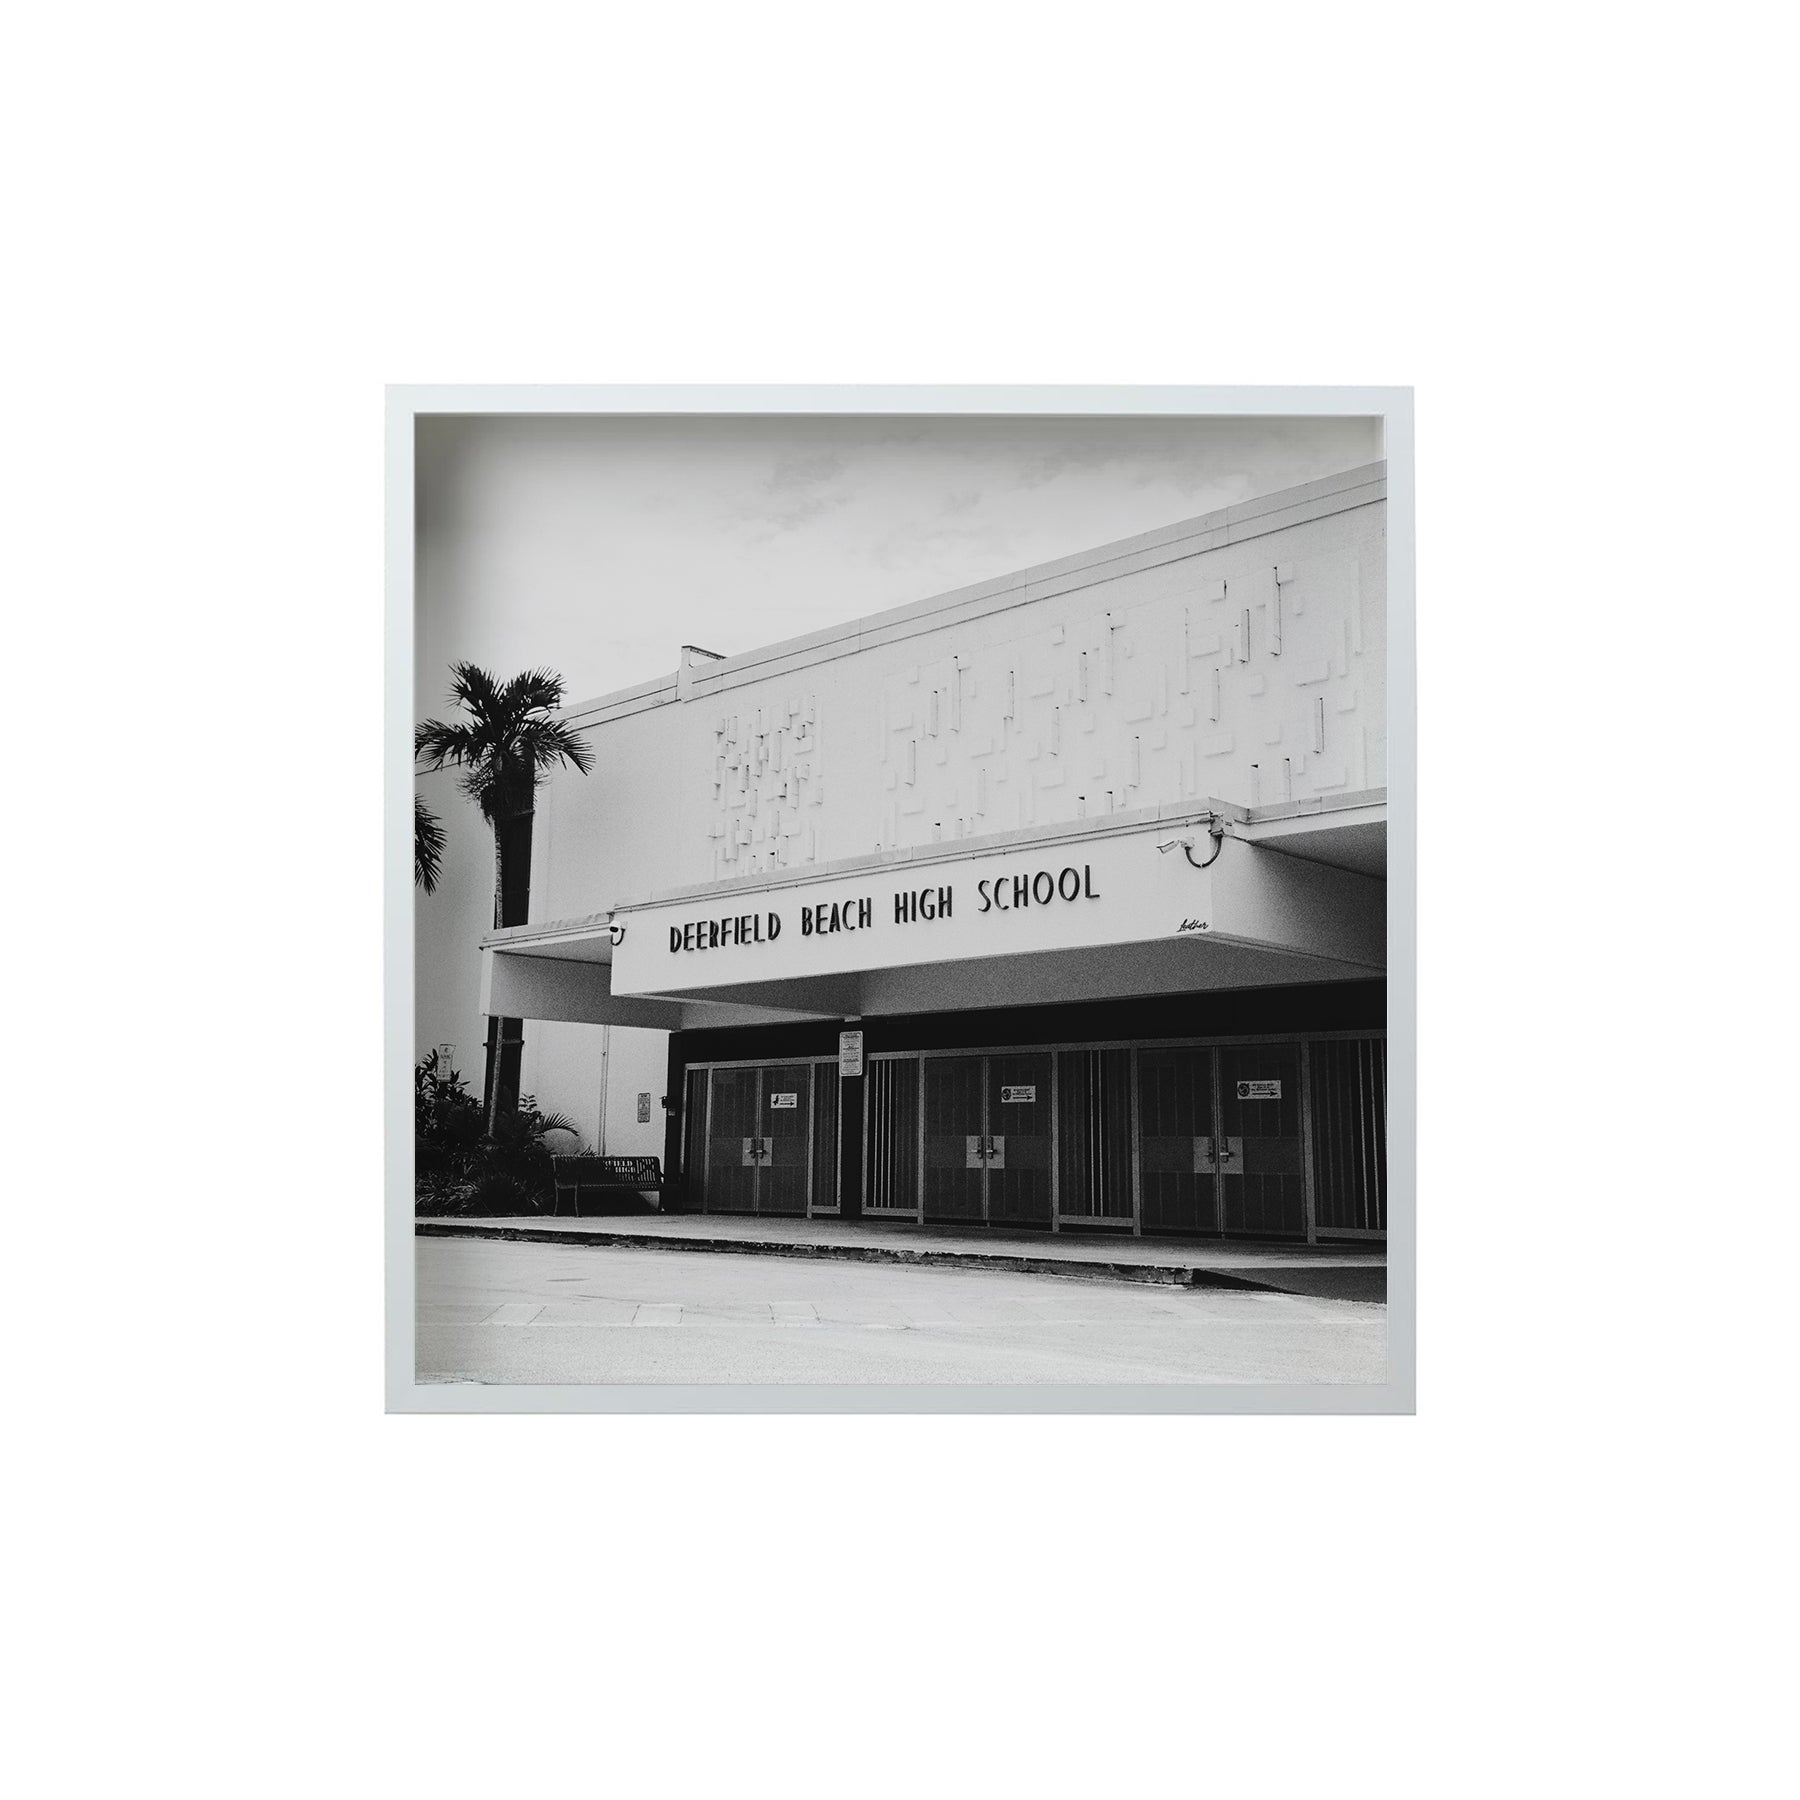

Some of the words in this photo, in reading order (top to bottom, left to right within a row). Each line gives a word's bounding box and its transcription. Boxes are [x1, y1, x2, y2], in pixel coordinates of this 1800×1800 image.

[669, 912, 782, 954] DEERFIELD
[801, 897, 873, 937] BEACH
[894, 885, 953, 925] HIGH
[977, 864, 1101, 913] SCHOOL
